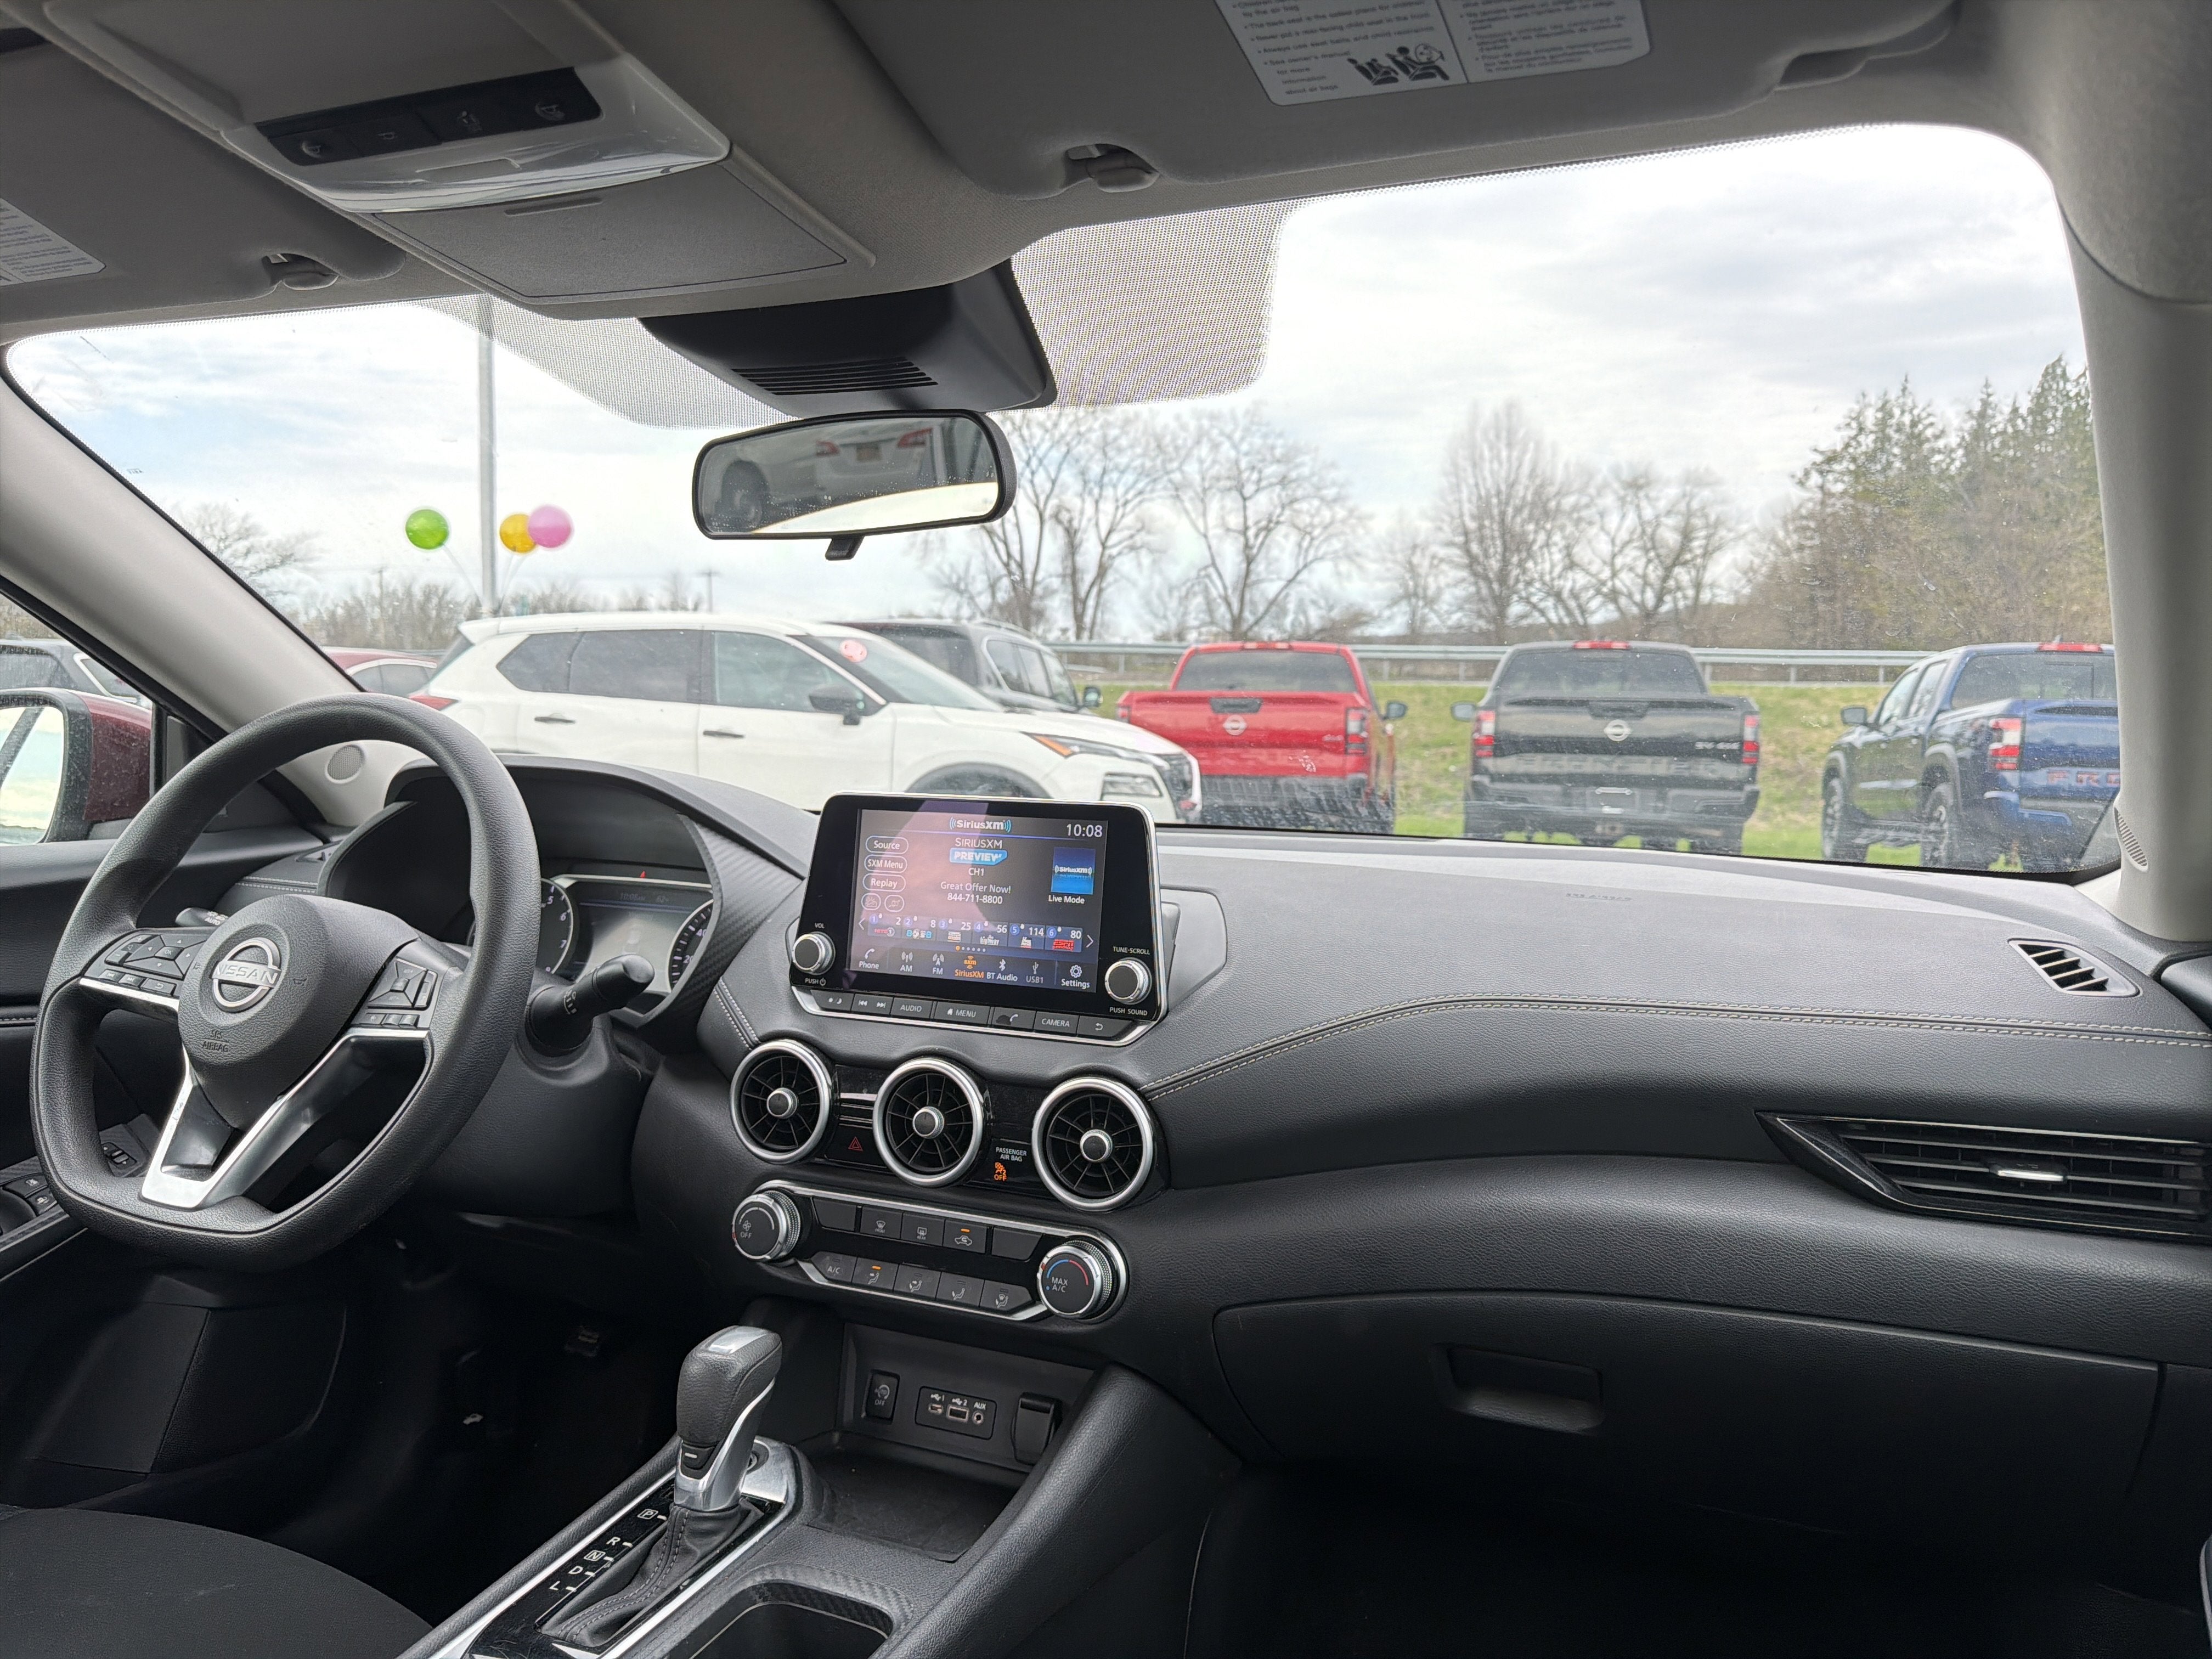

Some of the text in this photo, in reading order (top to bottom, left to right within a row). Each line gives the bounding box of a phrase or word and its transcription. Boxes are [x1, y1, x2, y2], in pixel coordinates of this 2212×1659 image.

[1066, 823, 1103, 838] 10:08
[873, 840, 900, 850] Source
[955, 837, 1003, 849] SIRIUSXM
[953, 851, 1002, 862] PREVIEW
[867, 859, 904, 869] SXM Menu
[968, 867, 985, 877] CH1
[871, 878, 898, 889] Replay
[940, 881, 1011, 894] Great Offer Now!
[547, 895, 554, 905] 5
[947, 893, 1003, 905] 844-711-8800
[1064, 896, 1085, 904] Mode
[204, 917, 221, 926] AUTO
[560, 912, 567, 922] 6
[896, 917, 901, 926] 2
[906, 918, 911, 926] 2
[930, 919, 936, 928] 8
[961, 922, 972, 931] 25
[997, 924, 1008, 934] 56
[1029, 927, 1044, 936] 114
[1070, 930, 1081, 939] 80
[859, 961, 879, 969] Phone
[216, 962, 278, 984] NISSAN
[955, 969, 984, 979] SiriusXM
[996, 973, 1018, 982] Audio
[1026, 975, 1043, 984] USB1
[1061, 978, 1090, 989] Settings
[900, 1004, 922, 1012] AUDIO
[956, 1009, 977, 1018] MENU
[1042, 1018, 1070, 1028] CAMERA
[996, 1147, 1027, 1156] PASSENGER
[1052, 1277, 1068, 1286] MAX
[1052, 1284, 1066, 1293] A/C
[973, 1402, 986, 1410] AUX
[606, 1537, 620, 1545] R
[568, 1566, 583, 1575] D
[549, 1581, 560, 1590] L
